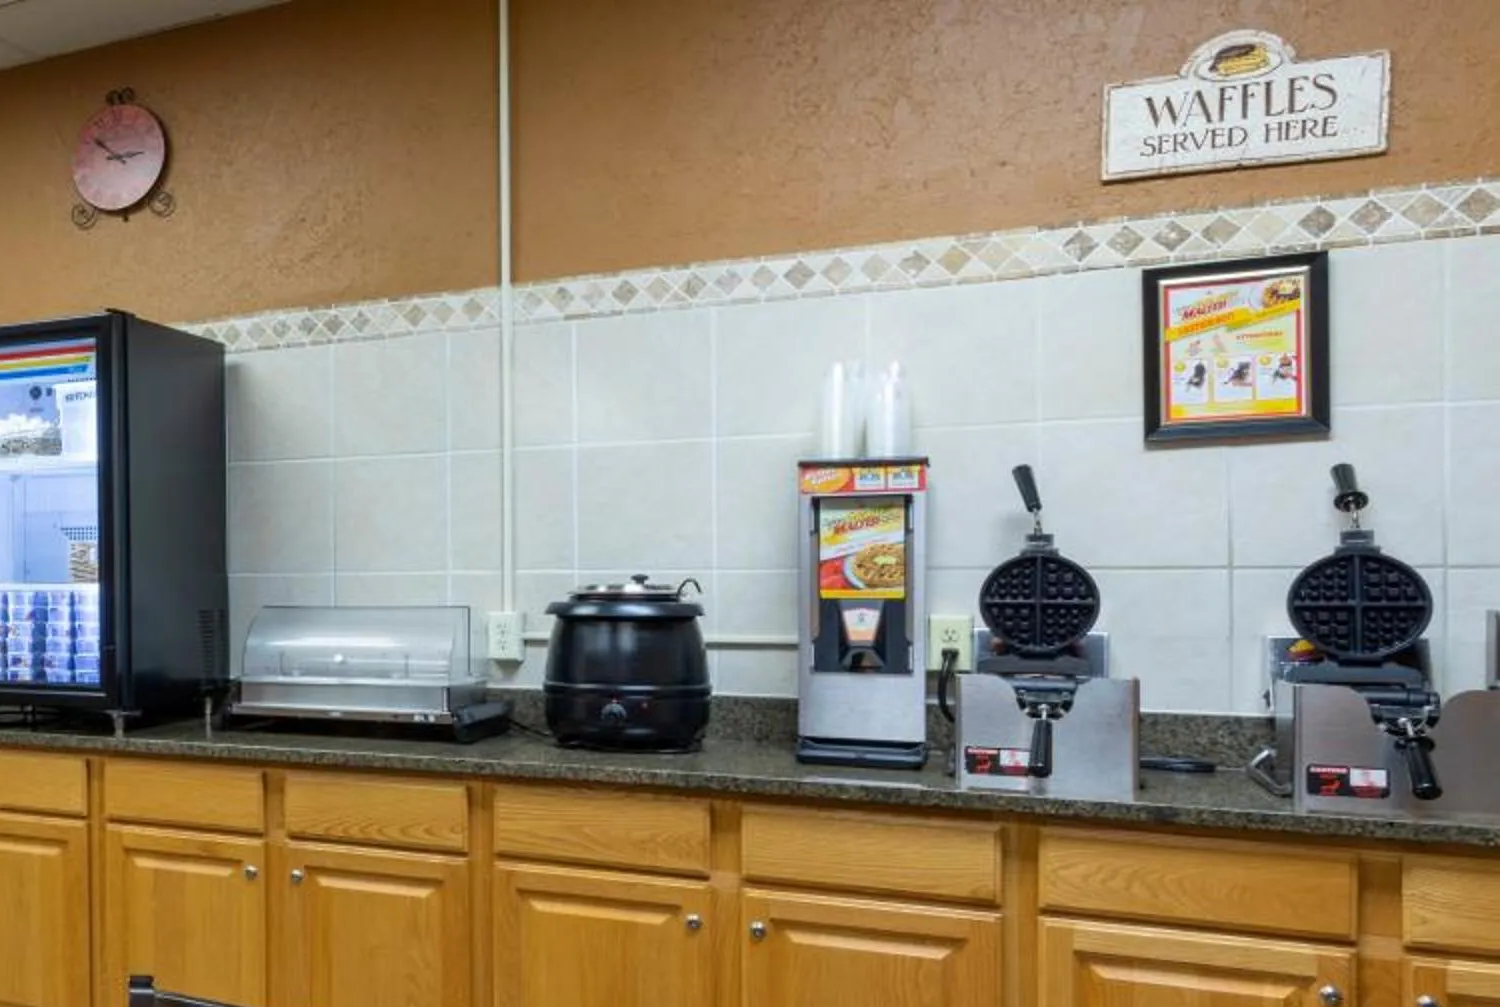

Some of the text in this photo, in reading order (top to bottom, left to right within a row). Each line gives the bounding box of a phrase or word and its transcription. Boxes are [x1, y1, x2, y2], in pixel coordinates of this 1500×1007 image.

[1144, 73, 1338, 128] WAFFLES
[1140, 115, 1338, 157] SERVED HERE
